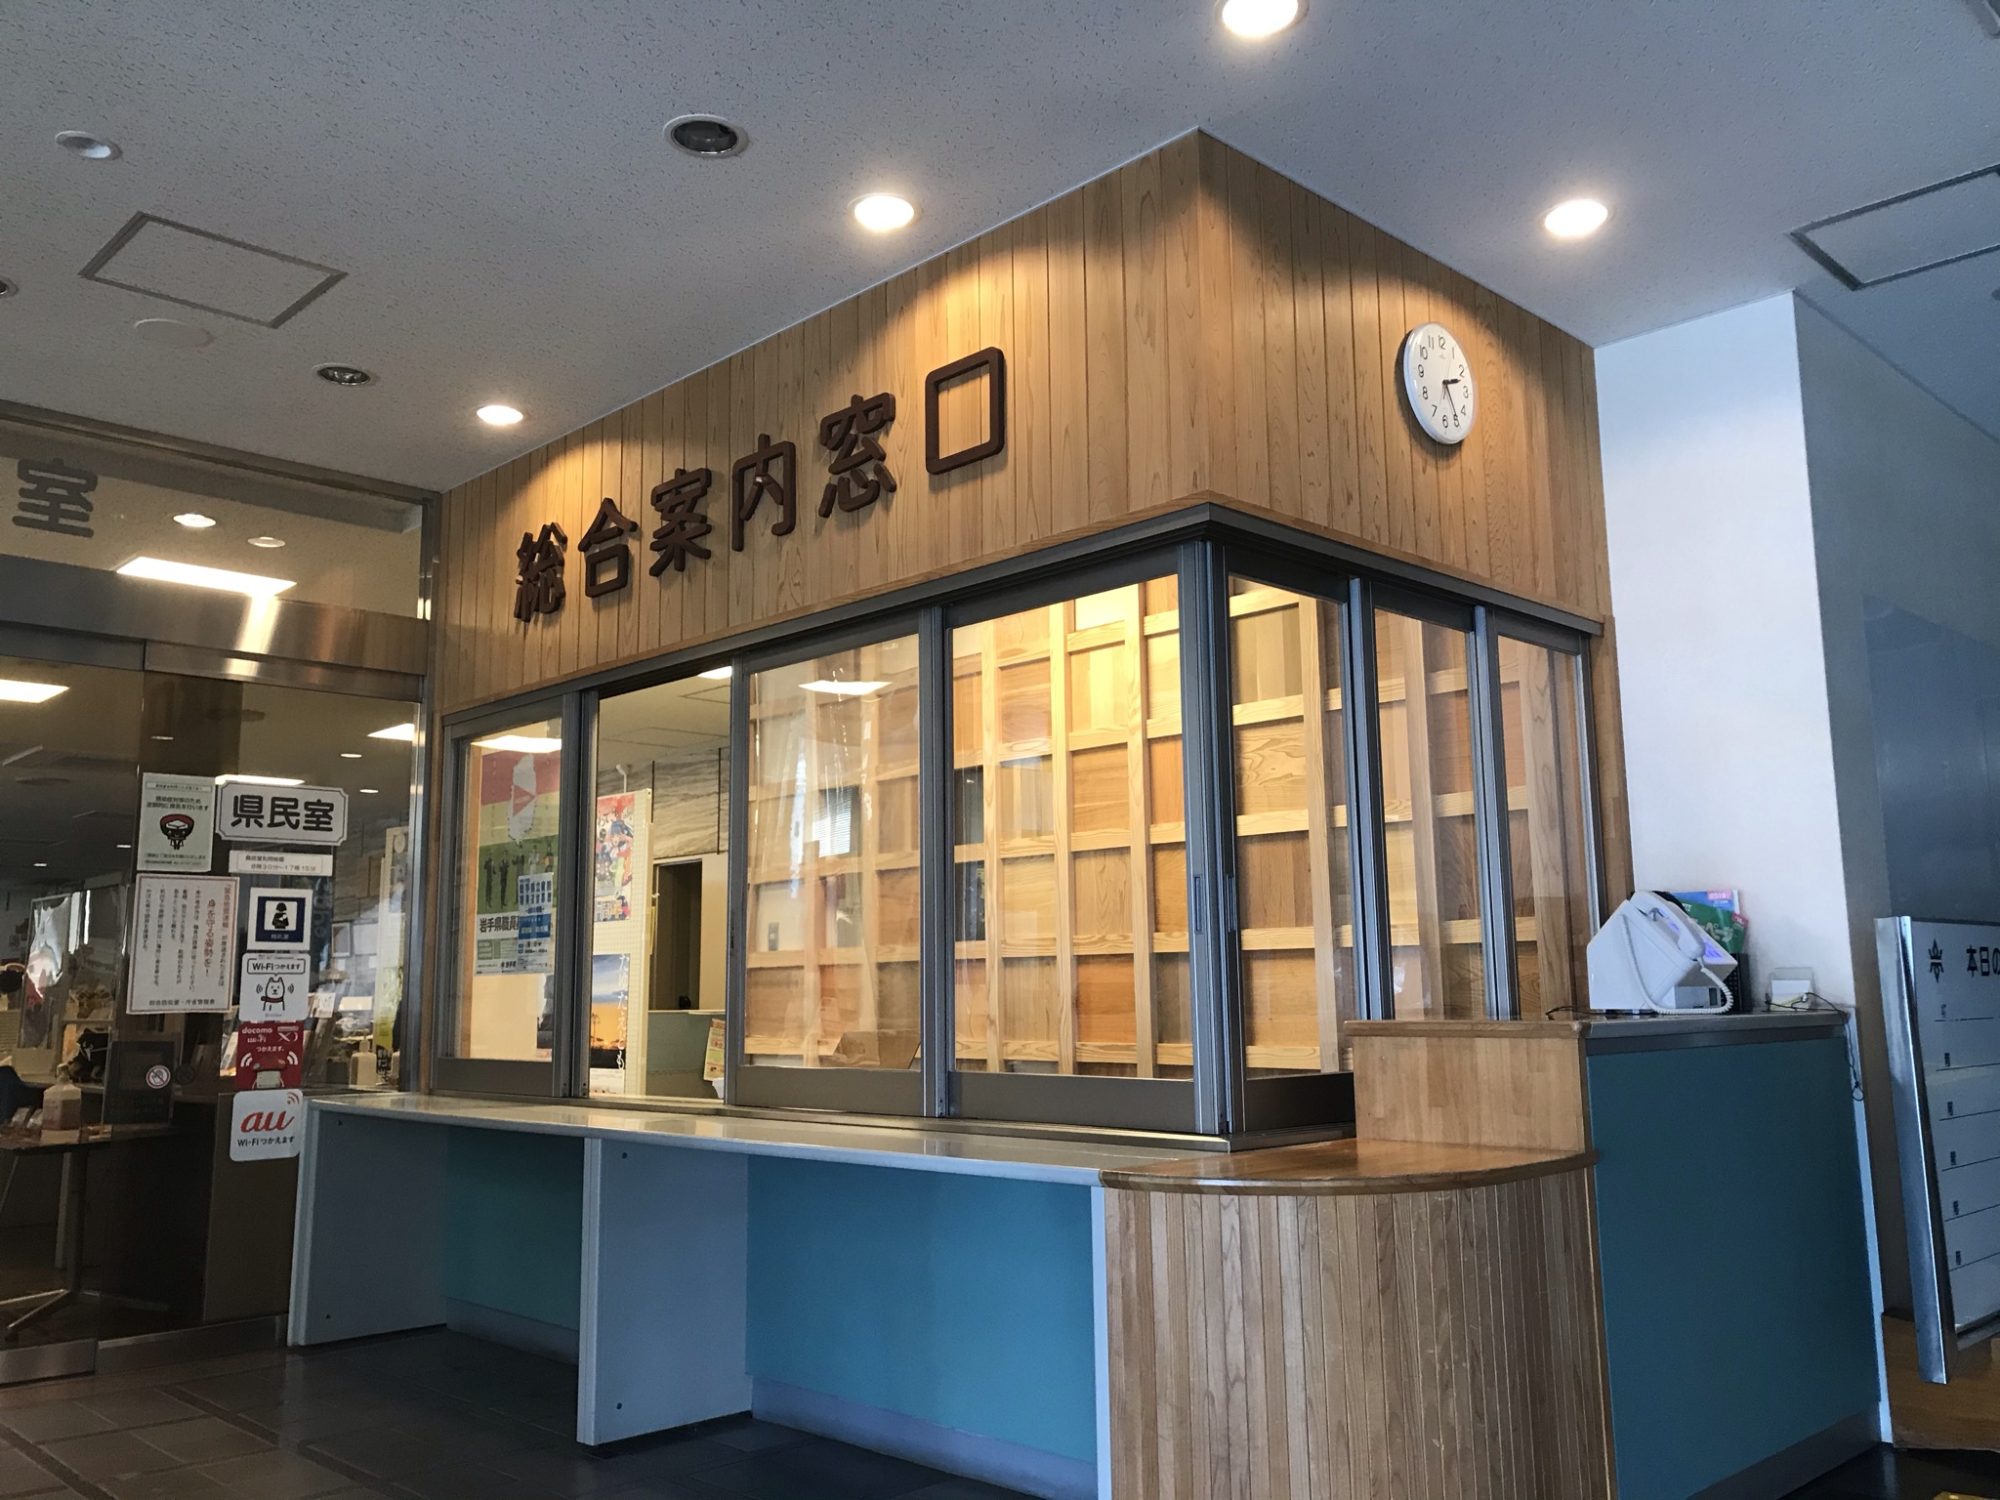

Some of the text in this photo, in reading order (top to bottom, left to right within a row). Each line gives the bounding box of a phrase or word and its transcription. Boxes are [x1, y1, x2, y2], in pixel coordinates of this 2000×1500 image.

[1428, 335, 1435, 349] 11
[1438, 335, 1446, 349] 12
[1420, 345, 1428, 360] 10
[1418, 364, 1425, 377] 9
[1459, 365, 1465, 377] 2
[1422, 386, 1428, 400] 8
[1463, 385, 1469, 398] 3
[1432, 404, 1438, 417] 7
[1460, 404, 1467, 416] 4
[1442, 414, 1449, 428] 6
[514, 346, 1005, 622] 総合案内窓口
[12, 457, 98, 538] 室
[231, 793, 335, 833] 県民室
[242, 1026, 273, 1034] docomo
[240, 1110, 295, 1133] au
